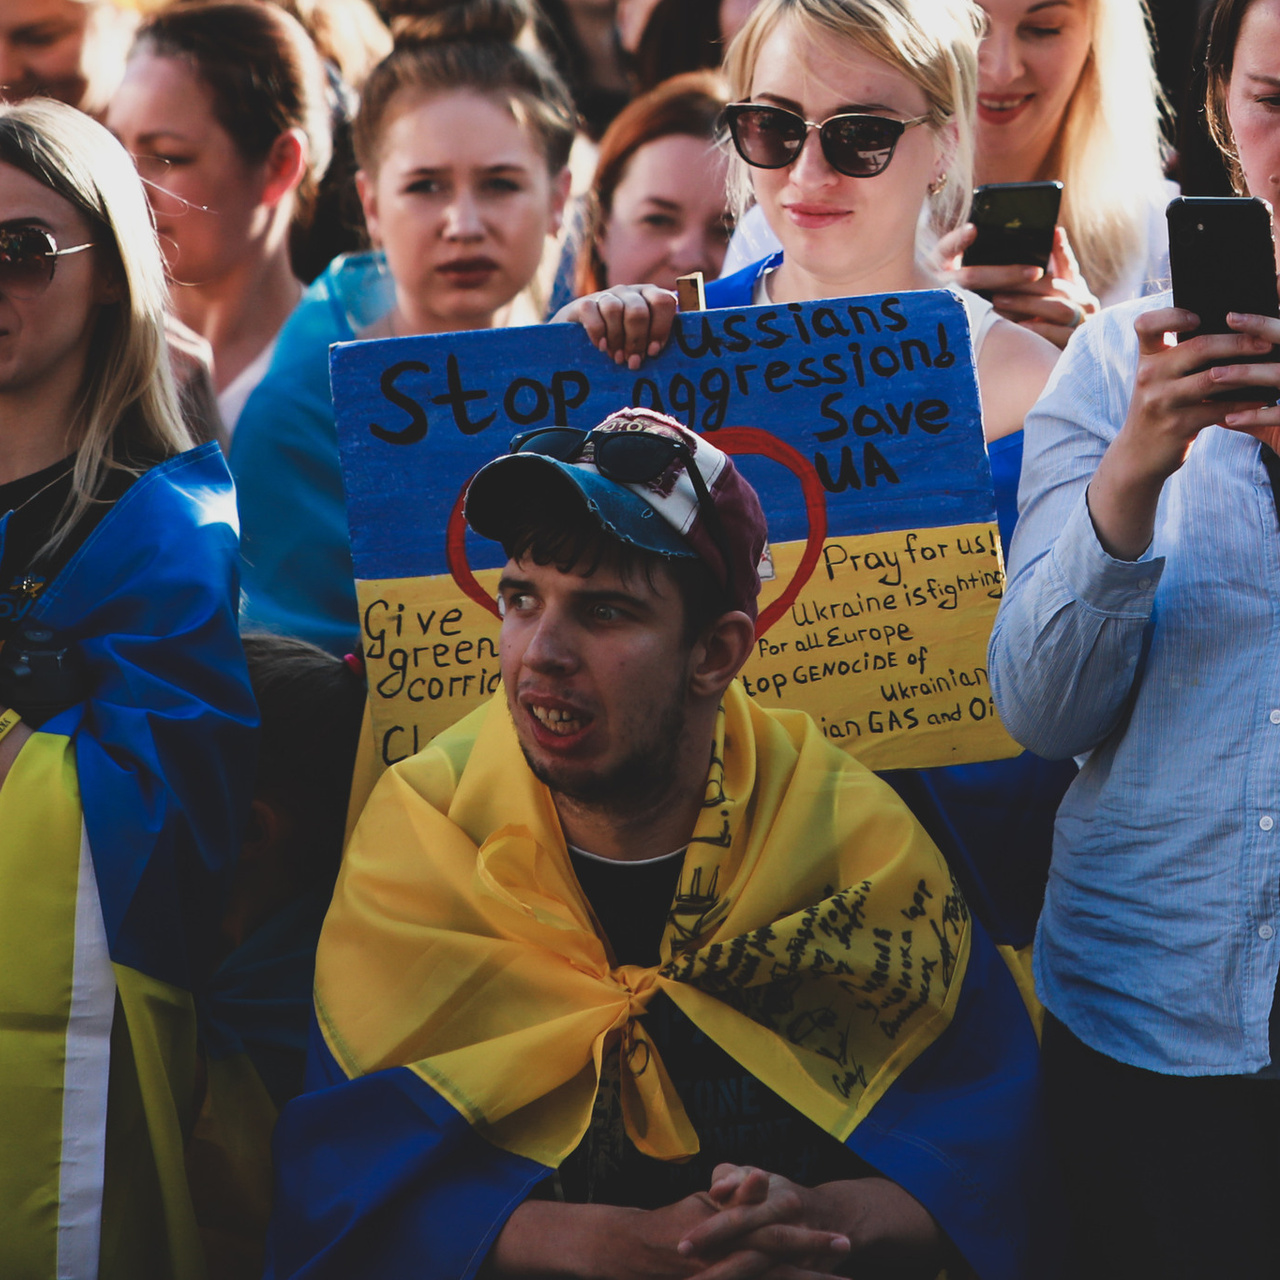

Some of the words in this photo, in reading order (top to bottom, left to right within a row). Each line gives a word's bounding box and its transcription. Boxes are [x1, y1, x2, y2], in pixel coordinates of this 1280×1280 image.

[674, 296, 908, 359] ussians
[369, 353, 591, 445] Stop
[632, 323, 955, 432] aggression!
[812, 392, 949, 442] Save
[814, 442, 900, 493] UA
[823, 544, 901, 587] Pray
[904, 533, 949, 563] for
[957, 530, 998, 557] us!
[365, 599, 463, 659] Give
[791, 593, 898, 627] Ukraine
[758, 637, 790, 658] for
[827, 623, 914, 648] Europe
[377, 637, 500, 699] green
[742, 674, 788, 699] top
[907, 646, 929, 674] of
[821, 717, 862, 738] ian
[868, 708, 919, 734] GAS
[926, 703, 962, 726] and
[969, 696, 995, 721] Oi
